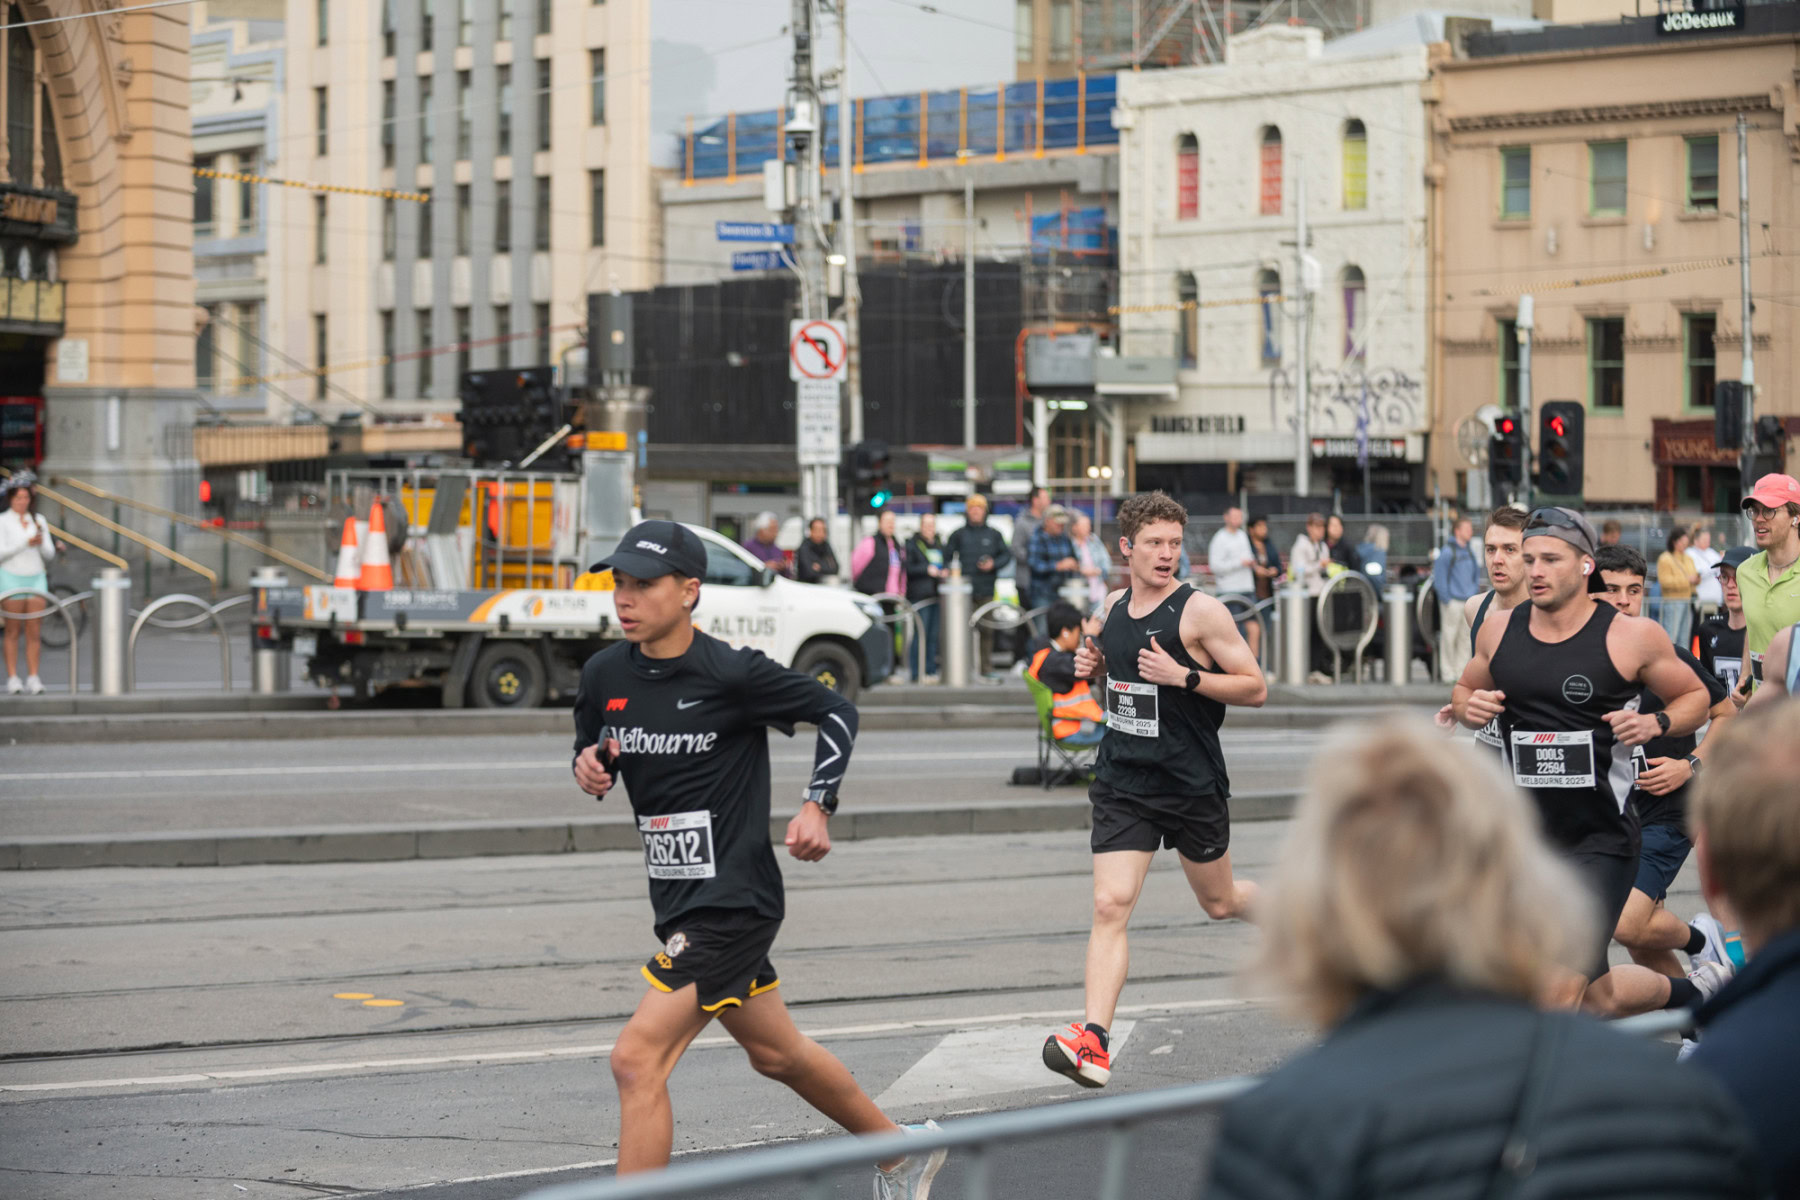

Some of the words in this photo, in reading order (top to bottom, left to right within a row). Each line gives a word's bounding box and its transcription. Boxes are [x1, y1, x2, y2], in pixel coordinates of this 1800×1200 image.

[1663, 11, 1735, 31] JCDecaux
[548, 596, 588, 609] ALTUS
[710, 616, 776, 636] ALTUS
[1135, 720, 1152, 728] 2025
[609, 726, 718, 754] Melbourne
[1536, 748, 1565, 761] DOOLS
[1536, 762, 1566, 774] 22594
[1521, 776, 1563, 785] MELBOURNE
[1565, 776, 1586, 785] 2025
[644, 830, 703, 865] 26212
[687, 867, 706, 876] 2025
